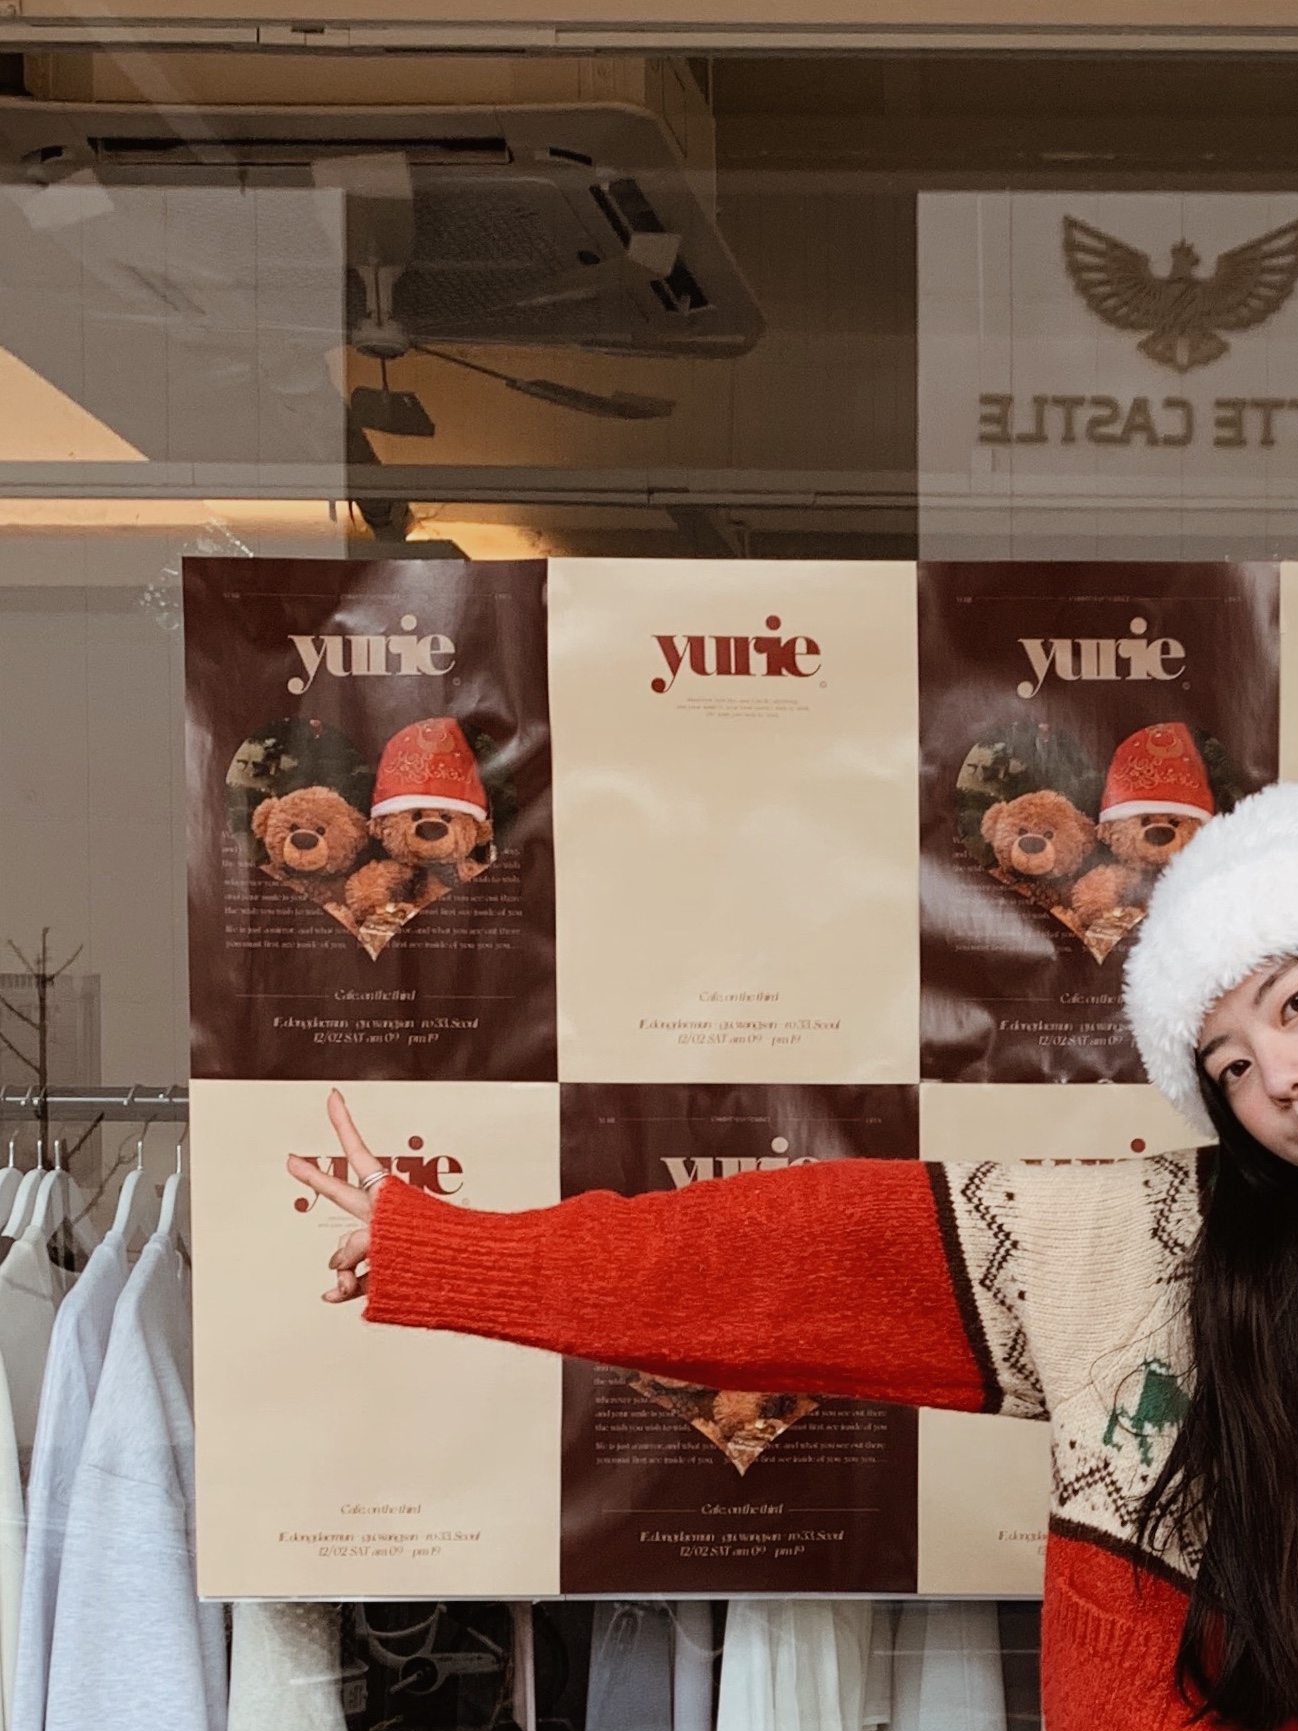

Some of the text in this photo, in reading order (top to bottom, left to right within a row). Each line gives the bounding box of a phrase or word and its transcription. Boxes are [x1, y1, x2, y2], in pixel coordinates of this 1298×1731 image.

[287, 614, 456, 695] yurie
[650, 615, 822, 694] yurie
[1017, 617, 1186, 699] yurie
